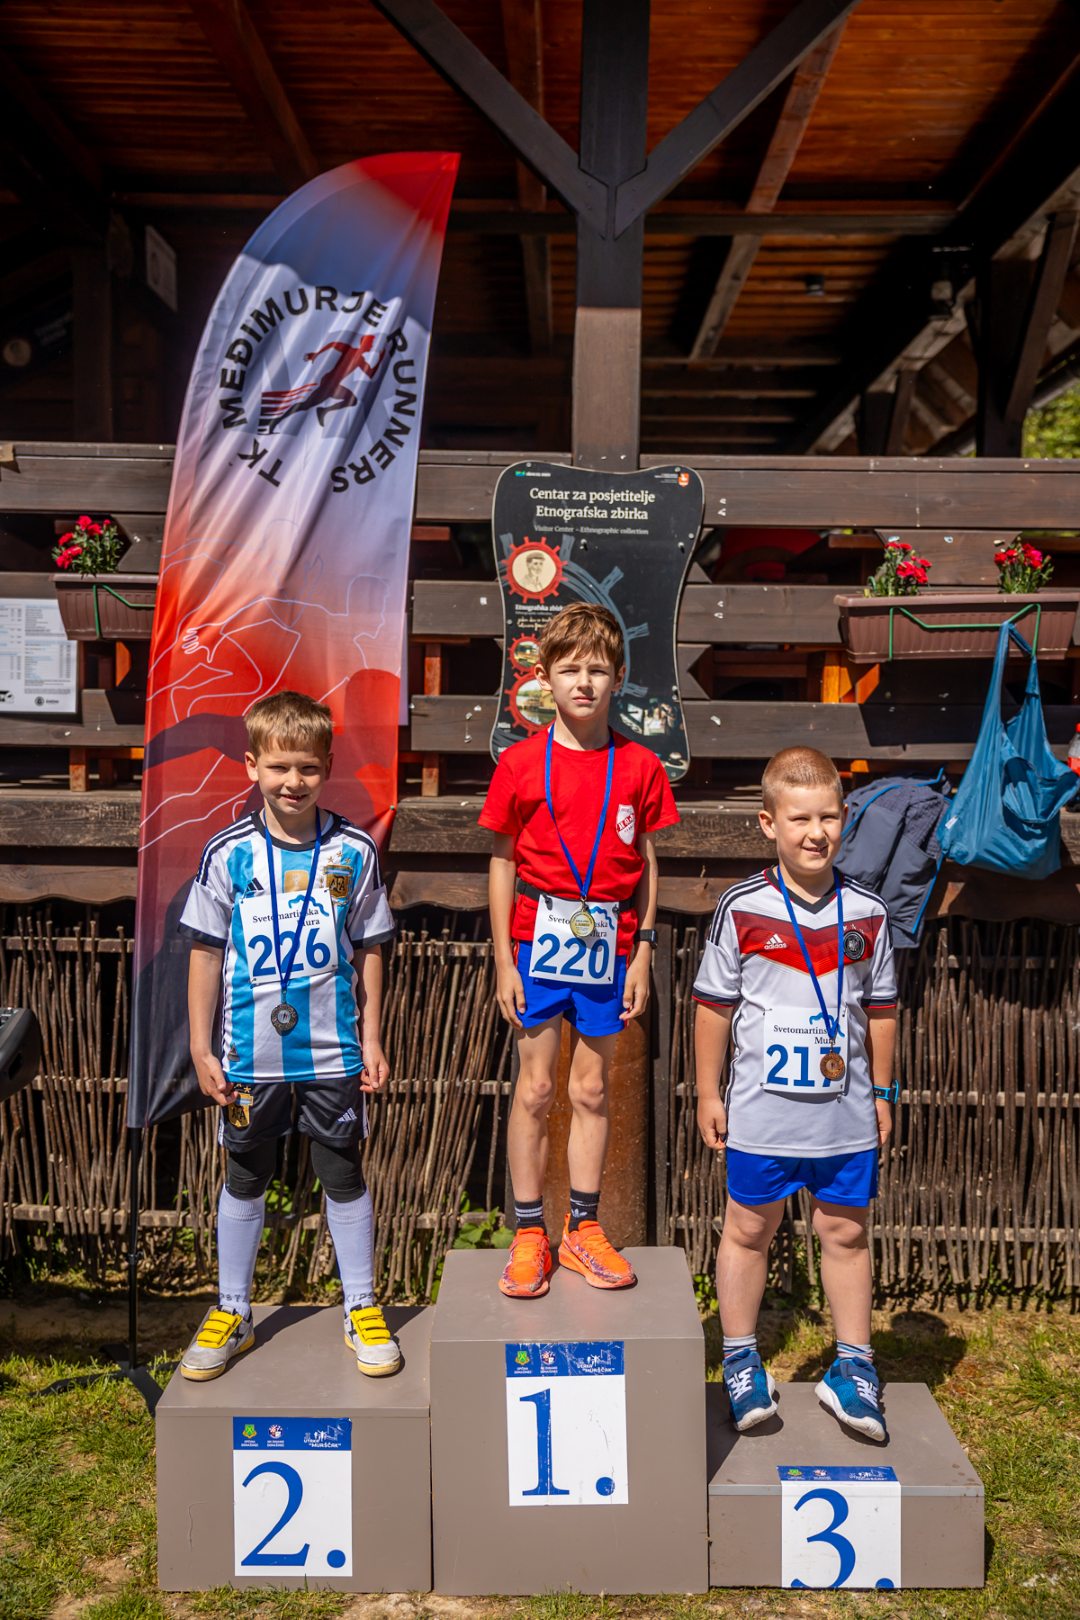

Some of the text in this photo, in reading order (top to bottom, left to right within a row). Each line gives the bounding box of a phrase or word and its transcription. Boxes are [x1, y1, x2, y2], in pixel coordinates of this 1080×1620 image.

[219, 286, 417, 493] TK MEĐIMURJE RUNNERS
[529, 487, 656, 505] Centar za posjetitelje
[536, 505, 649, 522] Etnografska zbirka
[580, 526, 620, 535] Ethnographic
[248, 927, 331, 978] 226
[532, 932, 610, 979] 220
[766, 1043, 841, 1088] 217
[519, 1388, 616, 1496] 1.
[241, 1461, 346, 1568] 2.
[790, 1488, 895, 1589] 3.
